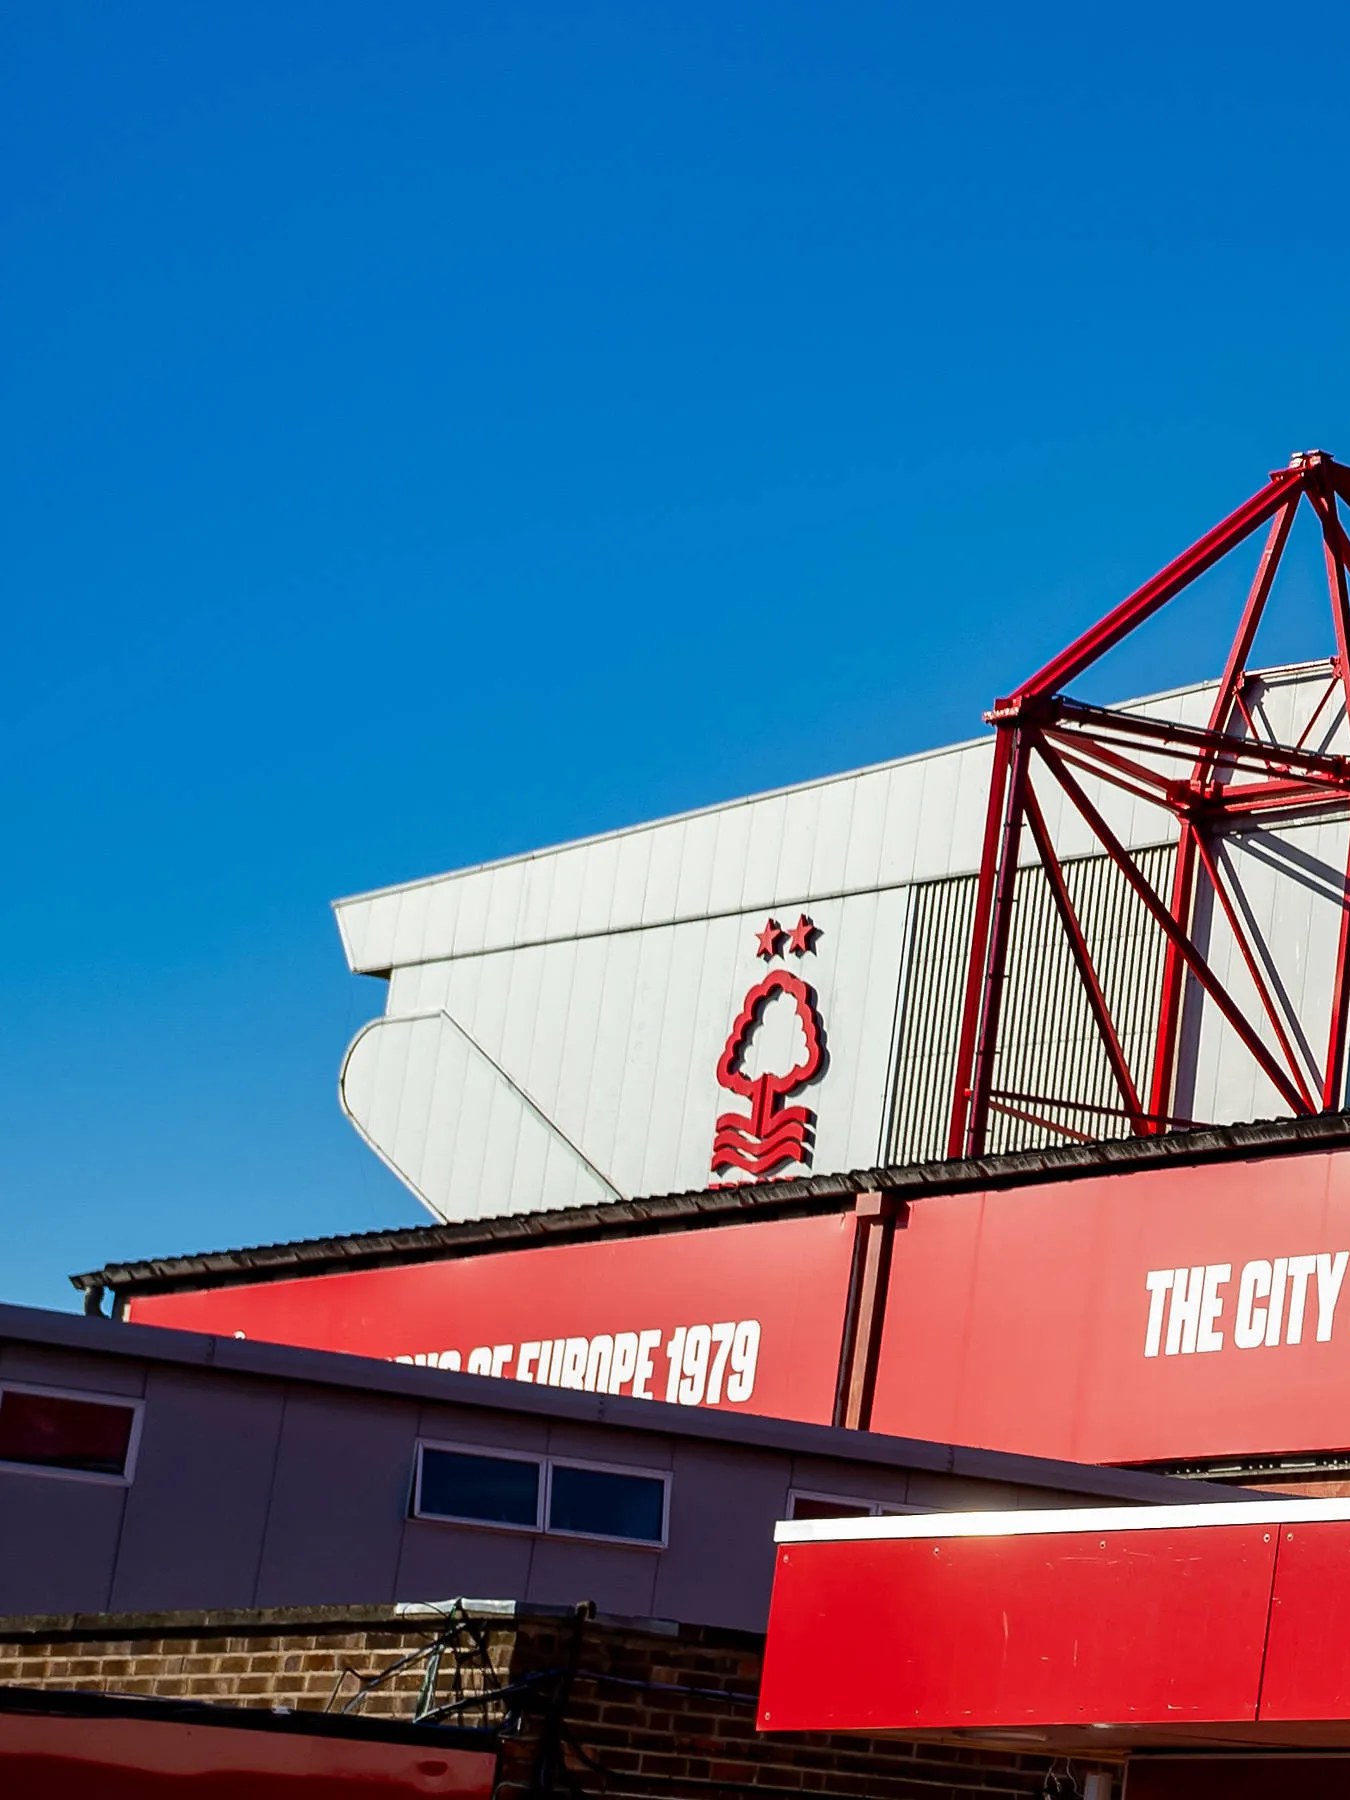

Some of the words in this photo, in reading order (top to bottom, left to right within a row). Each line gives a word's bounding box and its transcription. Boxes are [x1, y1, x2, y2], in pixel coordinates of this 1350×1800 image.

[1144, 1262, 1232, 1358] THE
[1234, 1251, 1350, 1349] CITY
[515, 1329, 662, 1400] EUROPE
[665, 1319, 761, 1406] 1979
